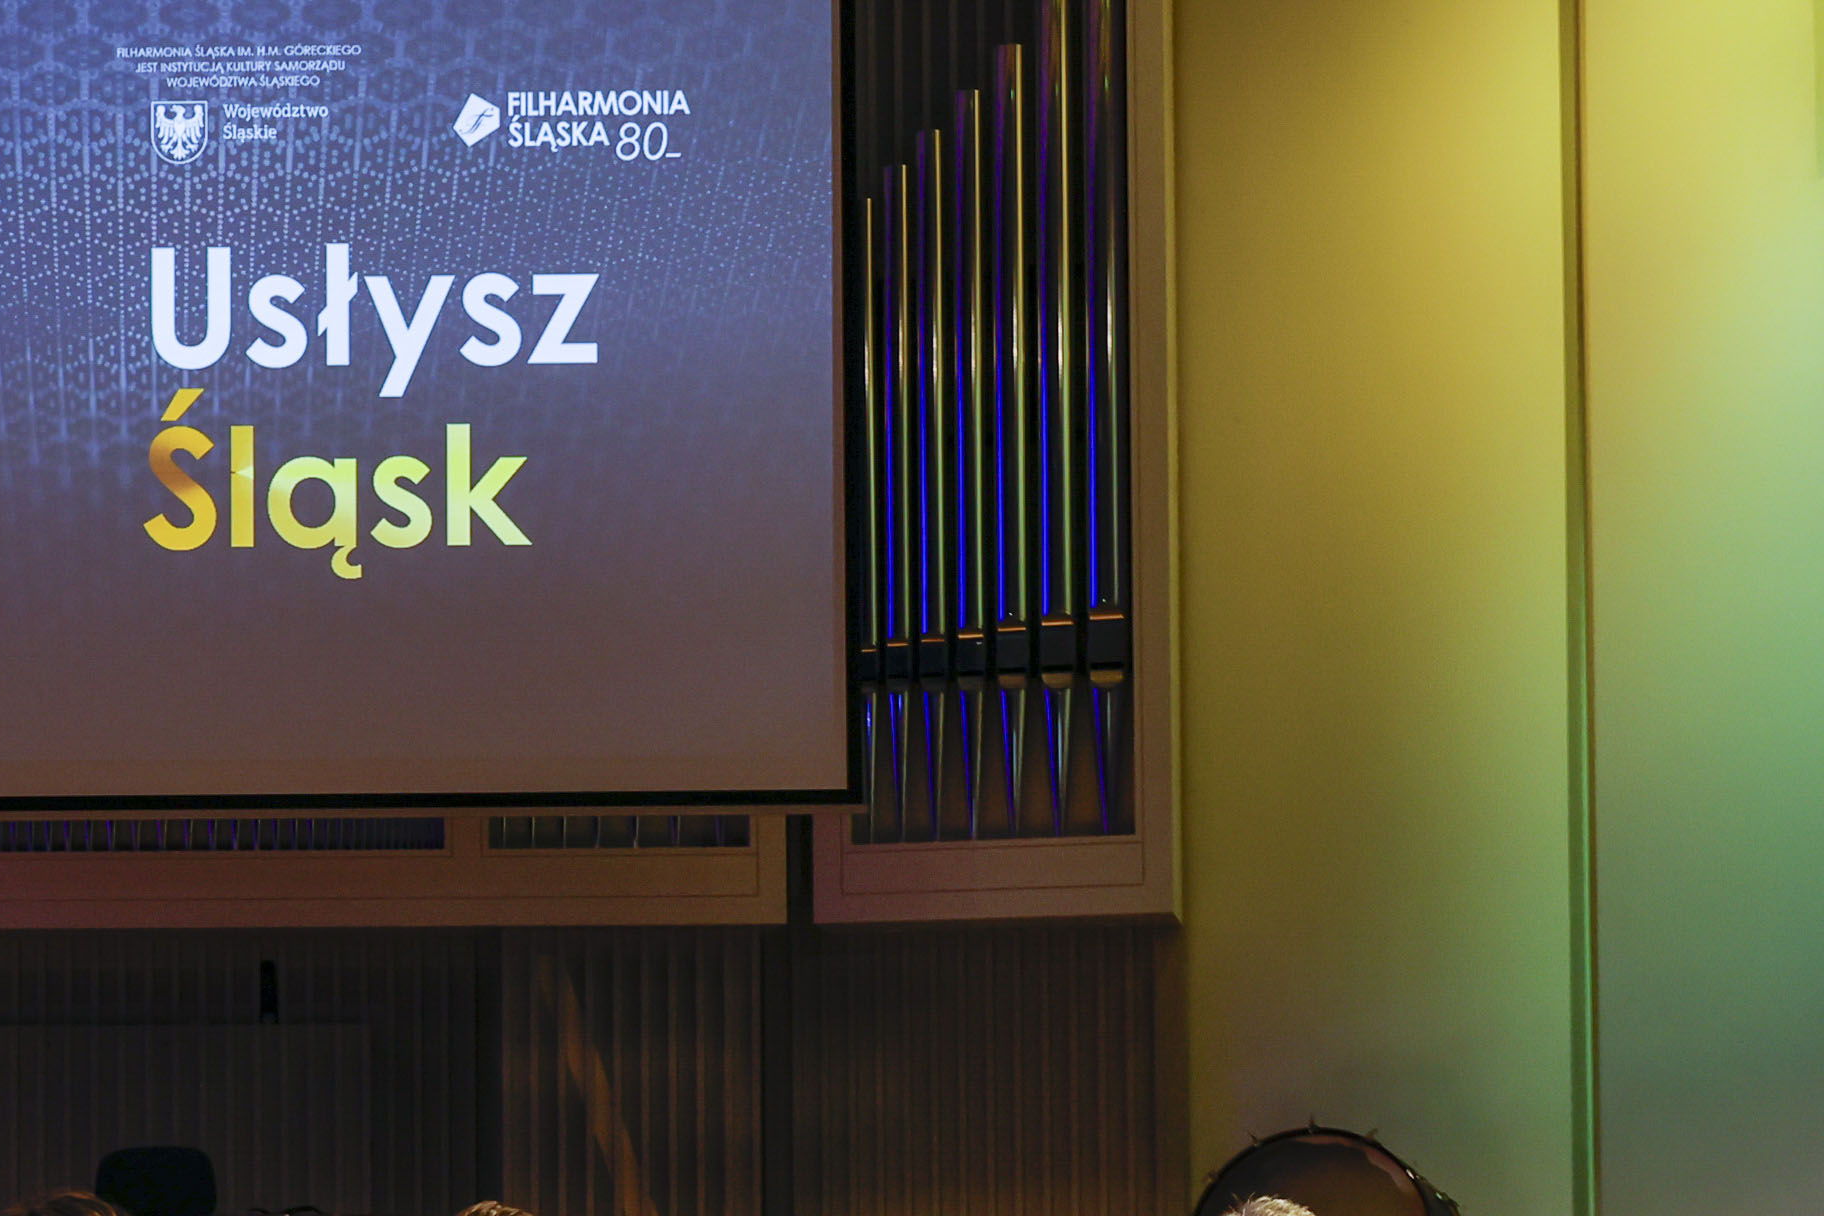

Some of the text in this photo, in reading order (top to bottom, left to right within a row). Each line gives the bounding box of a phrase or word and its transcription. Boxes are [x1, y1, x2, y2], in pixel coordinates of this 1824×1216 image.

[116, 43, 362, 60] FILHARMONIA ŚLĄSKA IM. H.M. GÓRECKIEGO
[135, 59, 346, 74] JEST INSTYTUCJĄ KULTURY SAMORZĄDU
[166, 74, 321, 89] WOJEWÓDZTWA ŚLĄSKIEGO
[223, 103, 329, 122] Województwo
[507, 89, 691, 117] FILHARMONIA
[223, 121, 278, 144] Śląskie
[508, 115, 611, 152] ŚLĄSKA
[150, 242, 601, 398] Usłysz
[143, 387, 533, 580] Śląsk
